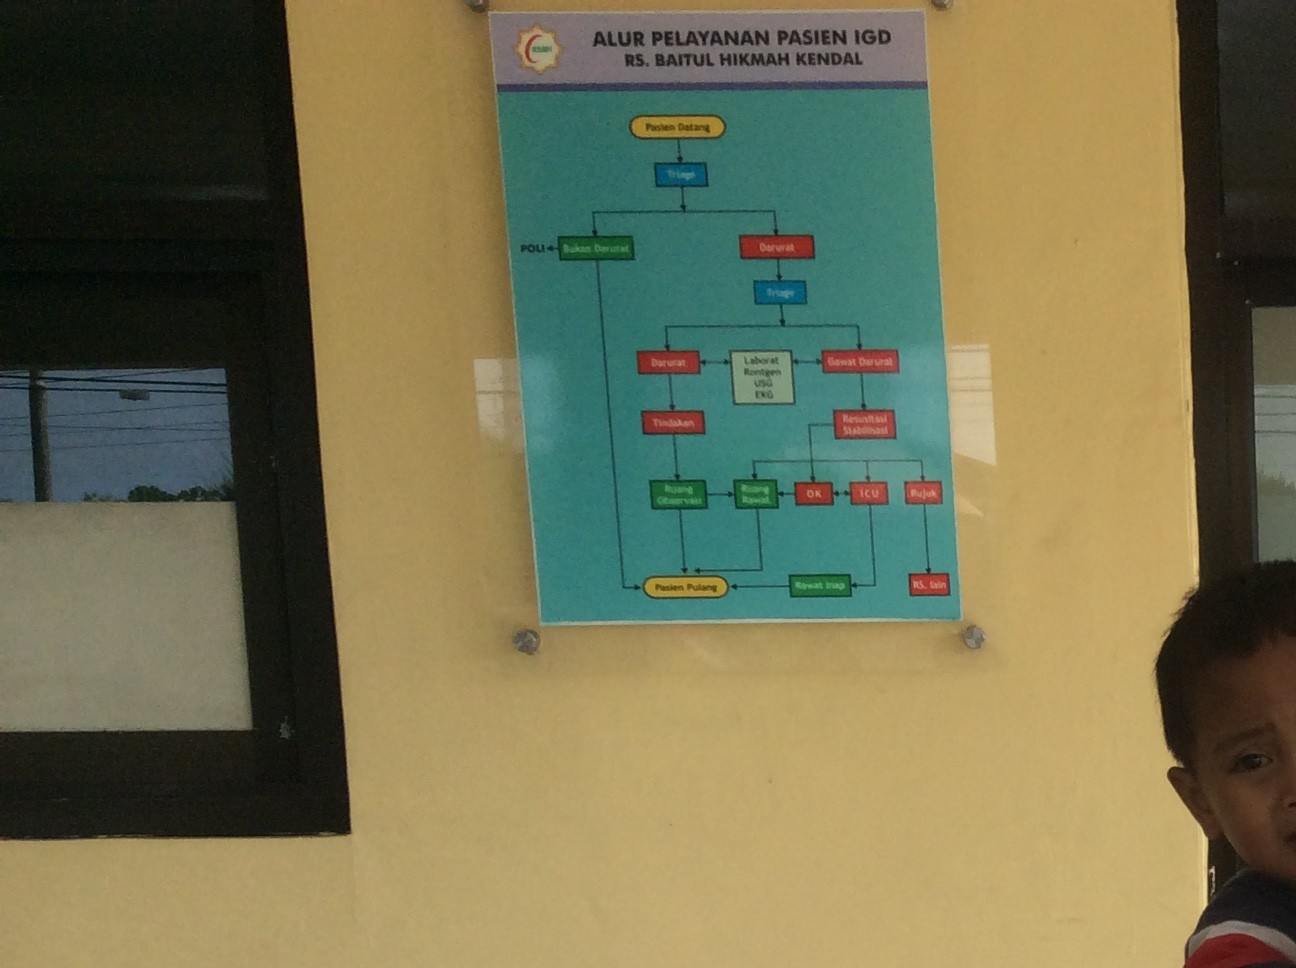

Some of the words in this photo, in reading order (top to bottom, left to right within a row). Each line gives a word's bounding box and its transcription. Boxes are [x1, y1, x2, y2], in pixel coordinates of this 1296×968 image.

[593, 31, 645, 47] ALUR
[652, 30, 770, 47] PELAYANAN
[777, 29, 847, 46] PASIEN
[854, 29, 892, 45] IGD
[625, 54, 649, 67] RS.
[655, 53, 714, 67] BAITUL
[720, 52, 790, 66] HIKMAH
[796, 52, 863, 66] KENDAL
[645, 122, 675, 132] Pasien
[678, 122, 710, 134] Datang
[521, 244, 545, 254] POLI
[759, 242, 795, 253] Darurat
[650, 357, 687, 368] Darurat
[743, 356, 780, 366] Laborat
[827, 356, 856, 367] Gawat
[858, 356, 894, 367] Darurat
[743, 368, 782, 378] Rontgen
[753, 379, 773, 388] USG
[754, 390, 774, 400] EKG
[806, 489, 823, 499] OK
[859, 489, 880, 499] ICU
[910, 488, 938, 500] Rujuk
[654, 582, 685, 592] Pasien
[687, 582, 718, 594] Pulang
